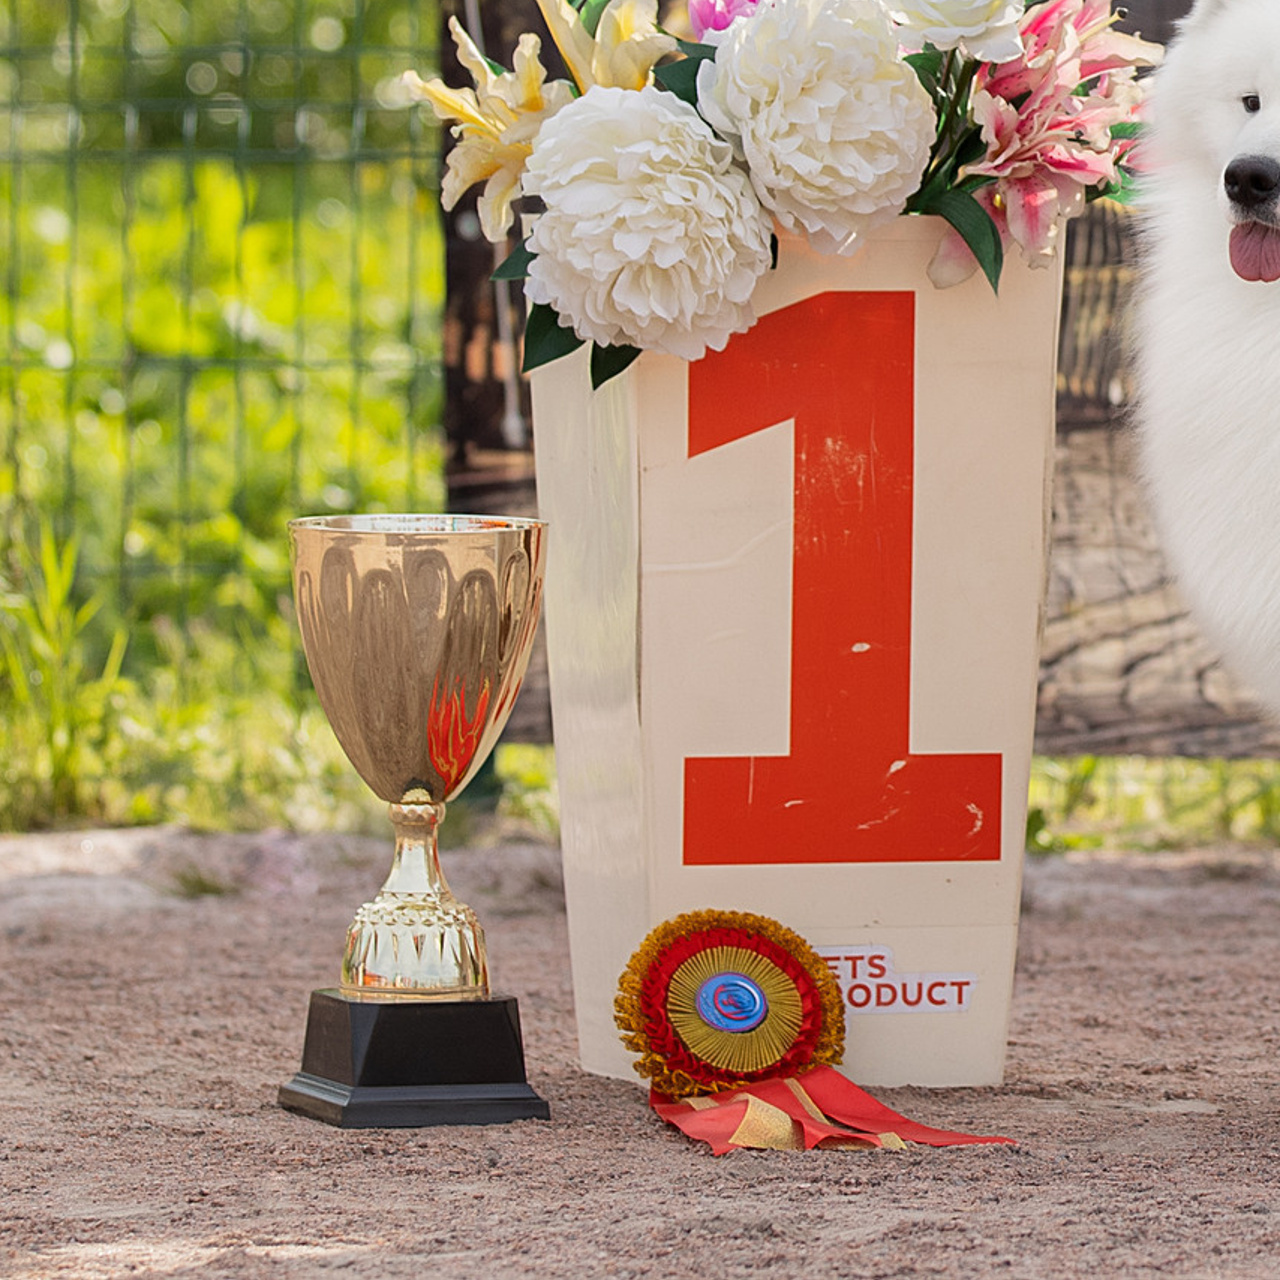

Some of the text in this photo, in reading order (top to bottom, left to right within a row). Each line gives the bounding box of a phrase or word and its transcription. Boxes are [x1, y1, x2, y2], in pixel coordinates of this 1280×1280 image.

[683, 290, 1003, 866] 1
[821, 954, 887, 980] ETS
[840, 981, 971, 1008] ODUCT
